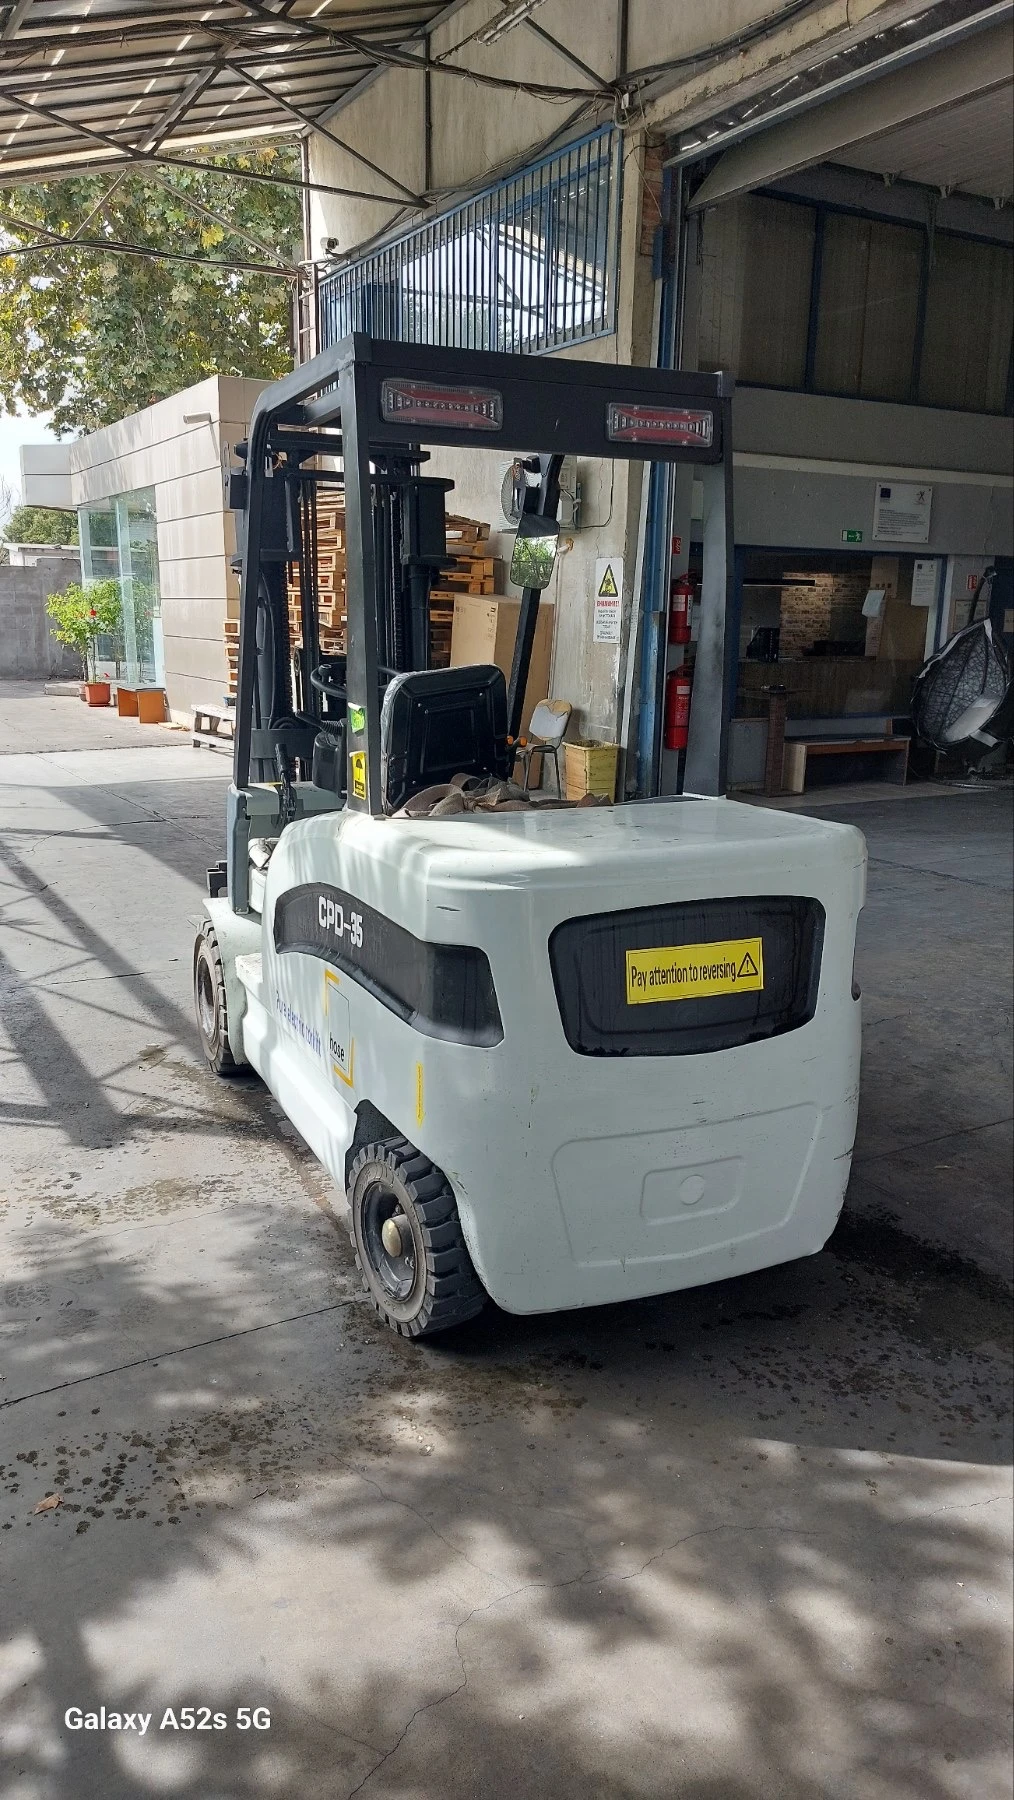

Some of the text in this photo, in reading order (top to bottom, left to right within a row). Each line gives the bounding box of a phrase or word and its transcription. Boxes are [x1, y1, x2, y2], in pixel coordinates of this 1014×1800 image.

[318, 895, 363, 948] CPD-35
[631, 957, 736, 992] Pay attention to reversing
[329, 1037, 345, 1063] hose
